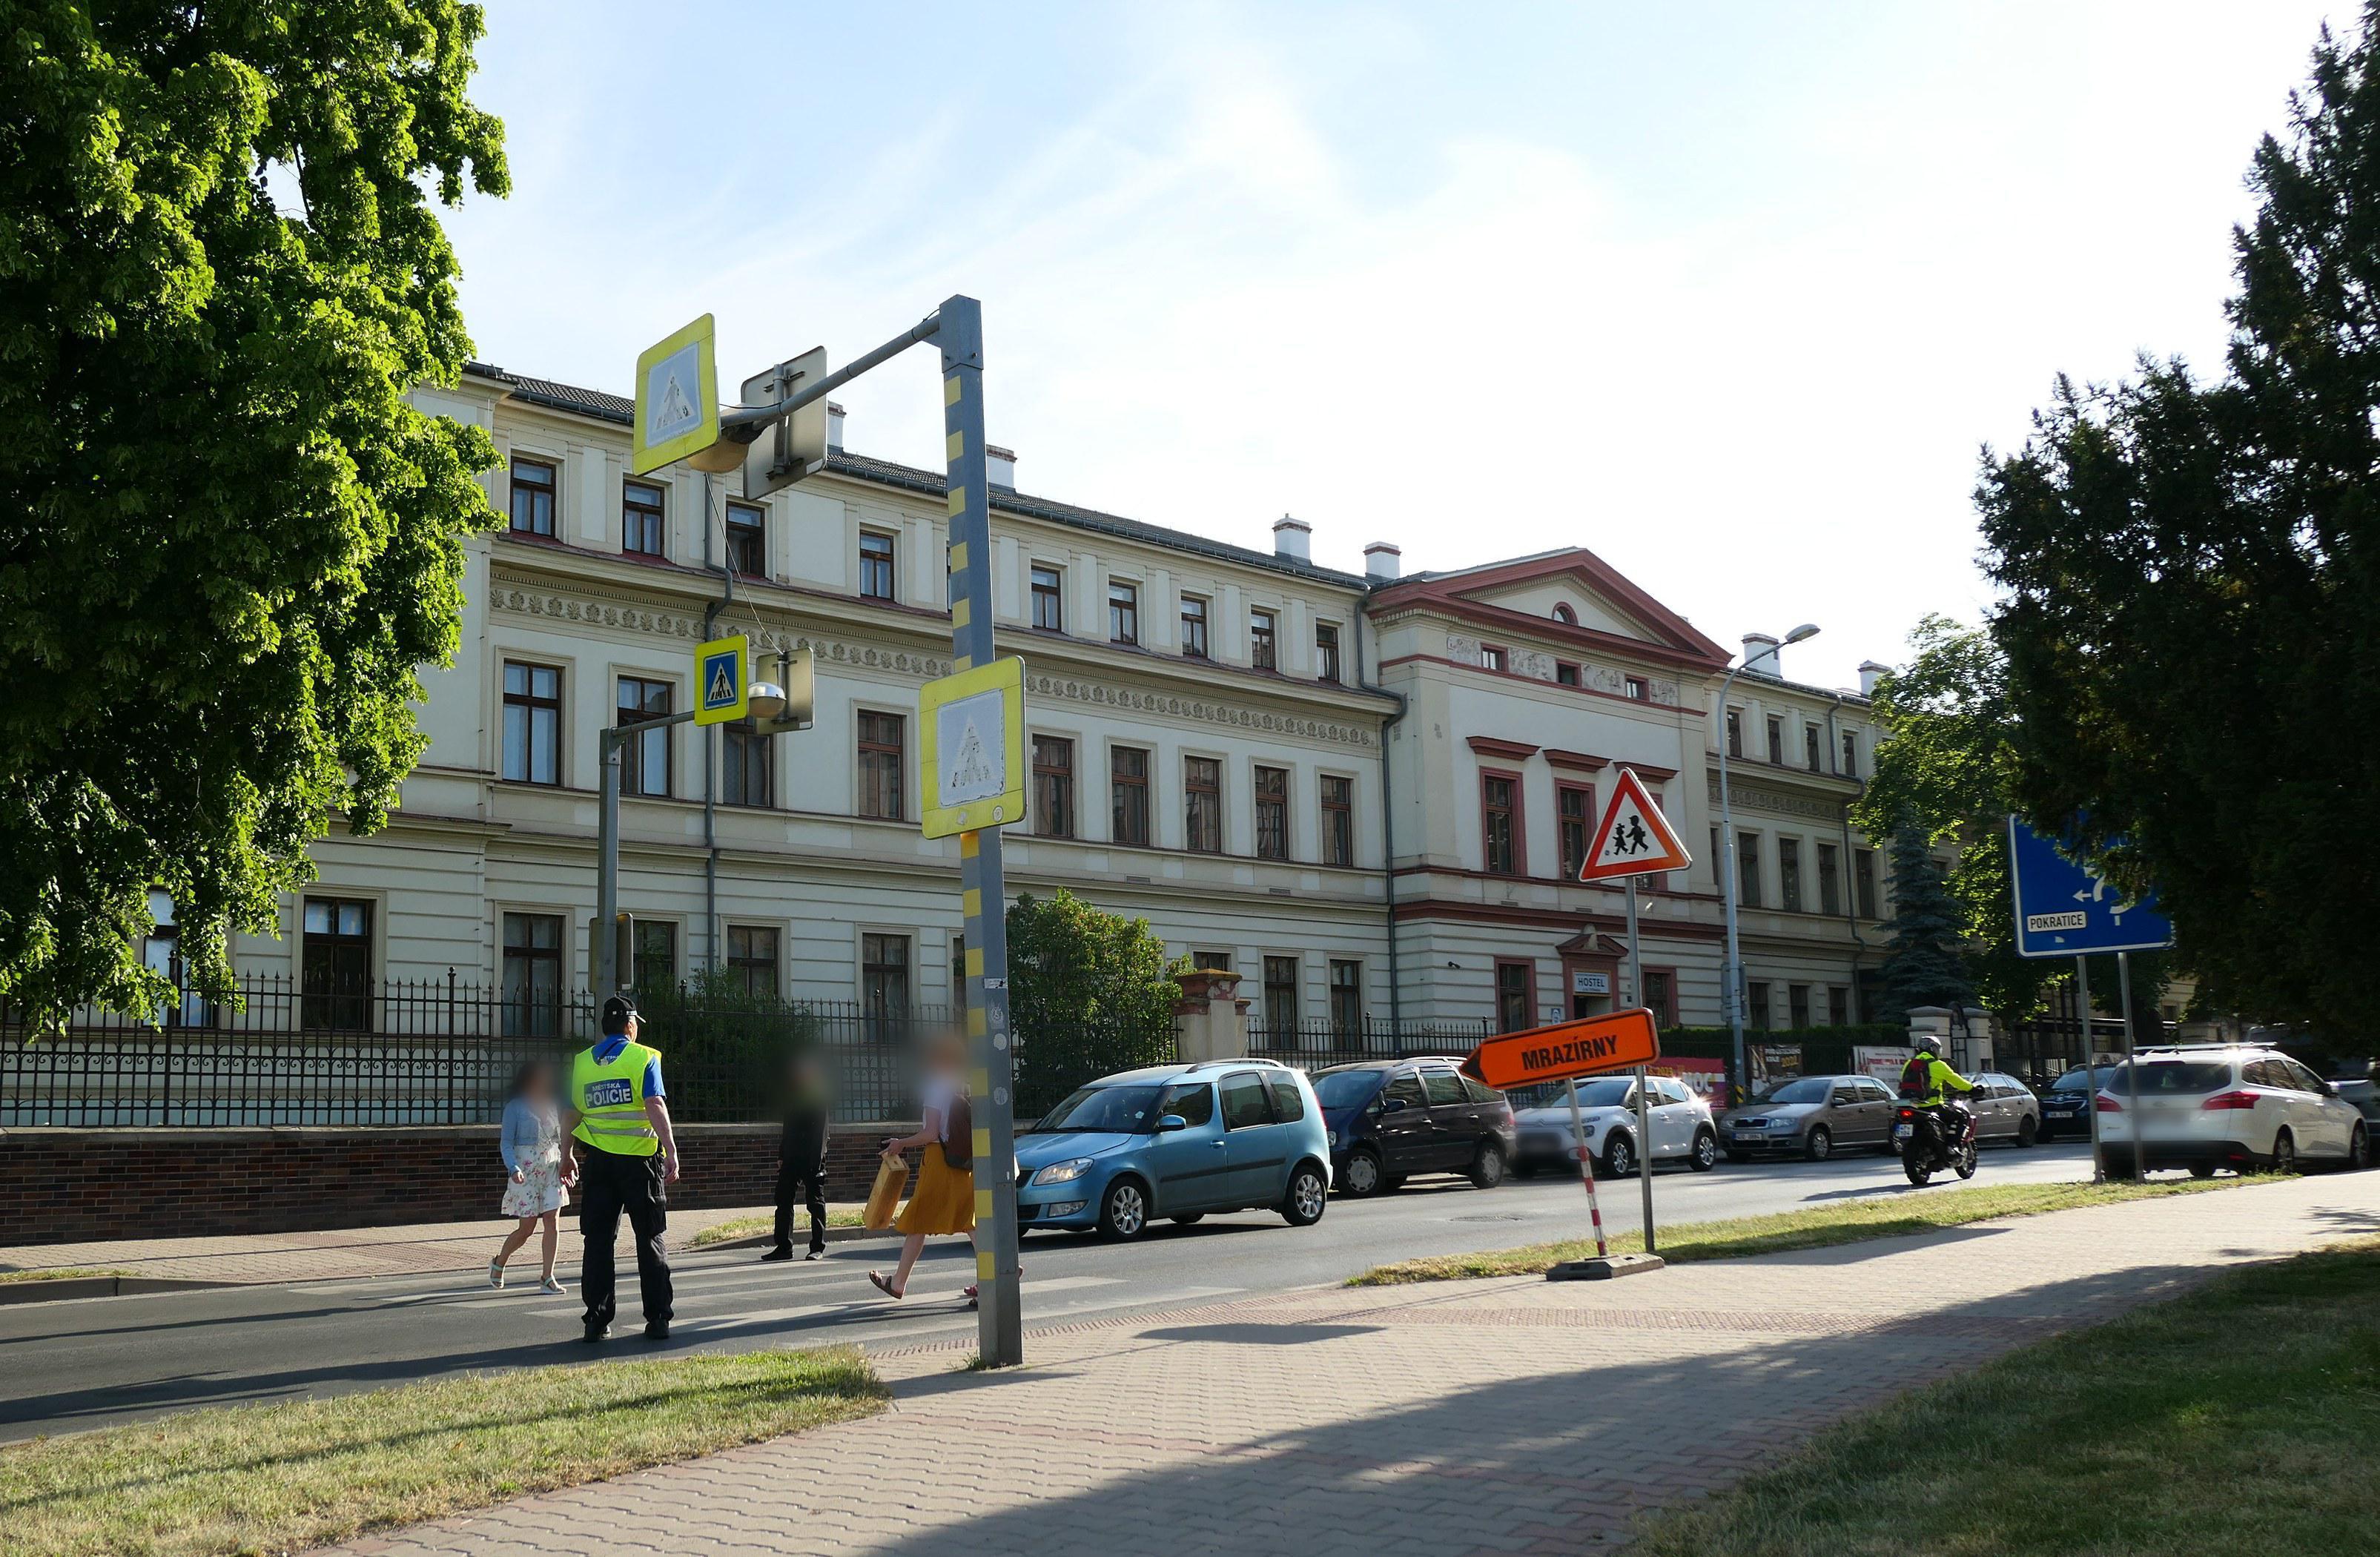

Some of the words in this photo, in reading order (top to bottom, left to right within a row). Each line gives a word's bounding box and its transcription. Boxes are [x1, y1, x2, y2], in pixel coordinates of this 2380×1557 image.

[2030, 914, 2083, 929] POKRATICE
[1578, 978, 1605, 987] HOSTEL
[1521, 1035, 1617, 1071] MRAZÍRNY
[592, 1082, 621, 1091] MĚSTSKÁ
[585, 1088, 632, 1106] POLICIE
